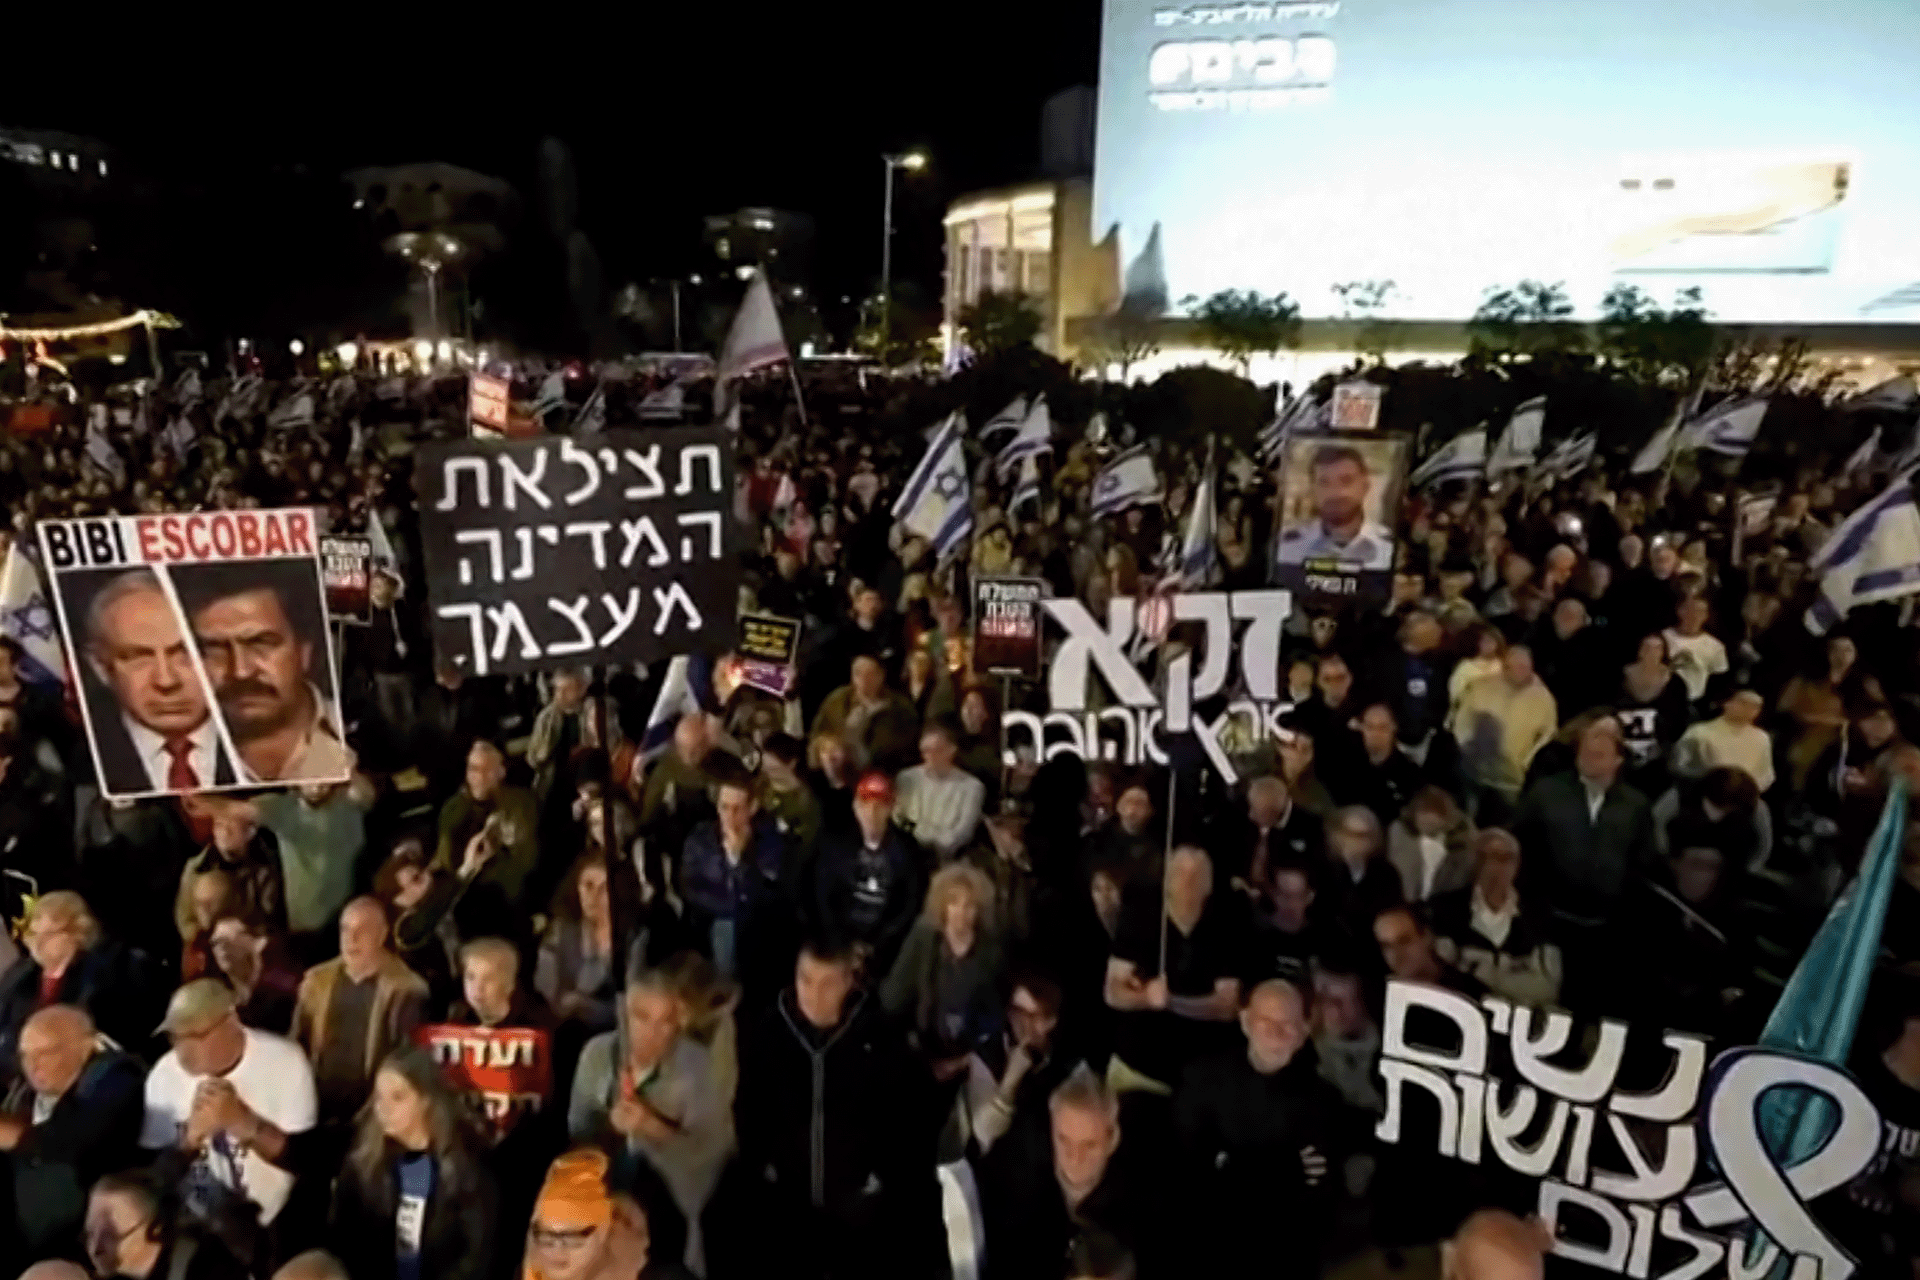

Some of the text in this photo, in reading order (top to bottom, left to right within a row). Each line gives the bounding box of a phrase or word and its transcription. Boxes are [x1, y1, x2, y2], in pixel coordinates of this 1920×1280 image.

[44, 512, 312, 567] BIBI ESCOBAR
[454, 510, 723, 585] המדינה
[1002, 698, 1296, 786] ארץ אהובה
[1383, 979, 1714, 1122] נשים
[1374, 1059, 1698, 1202] עושות
